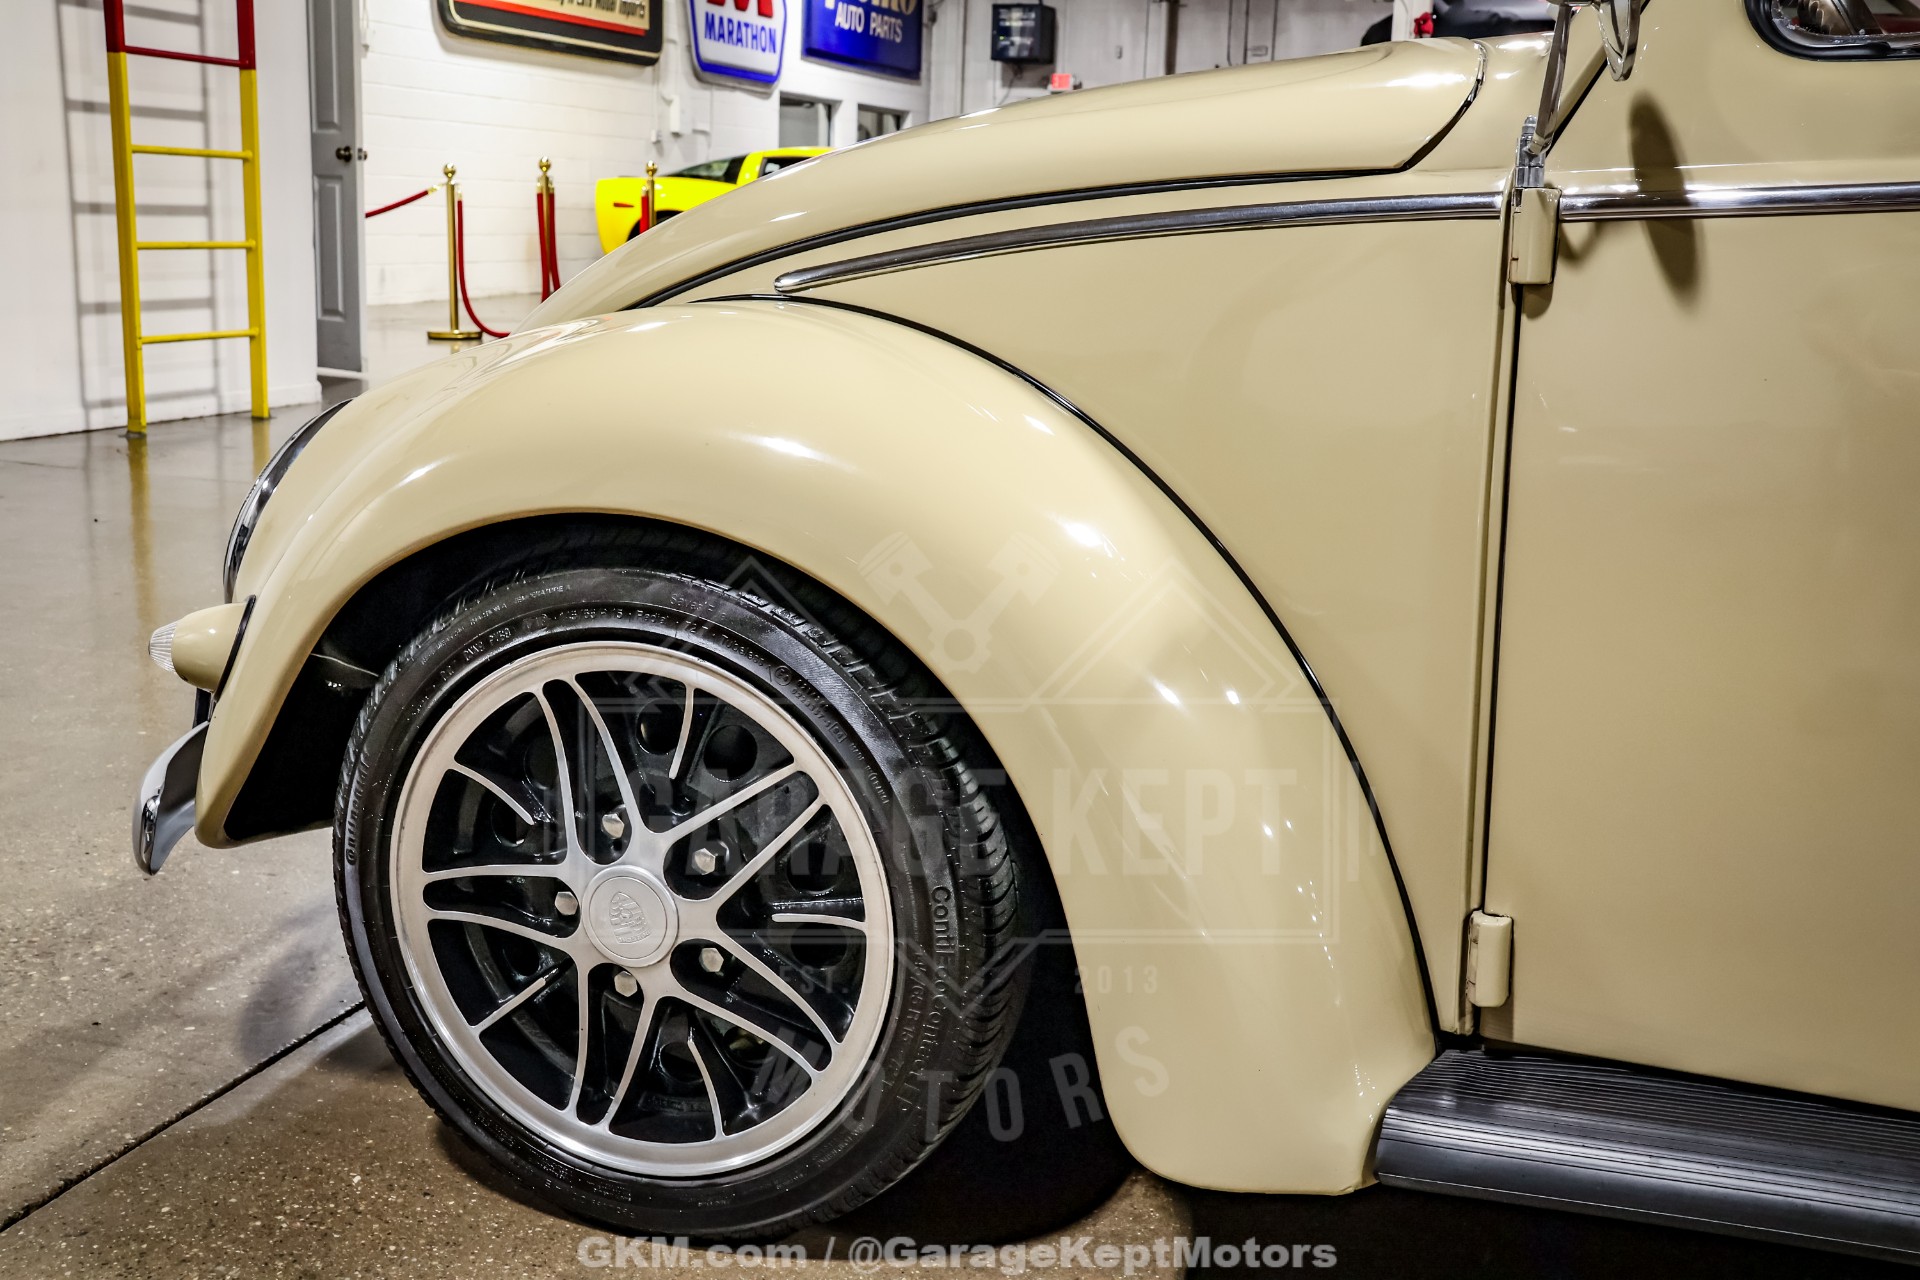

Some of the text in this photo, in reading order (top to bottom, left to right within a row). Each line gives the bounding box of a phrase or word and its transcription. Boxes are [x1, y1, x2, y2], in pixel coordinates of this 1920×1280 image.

[705, 11, 776, 53] MARATHON
[834, 1, 865, 33] AUTO
[869, 12, 903, 43] PARTS
